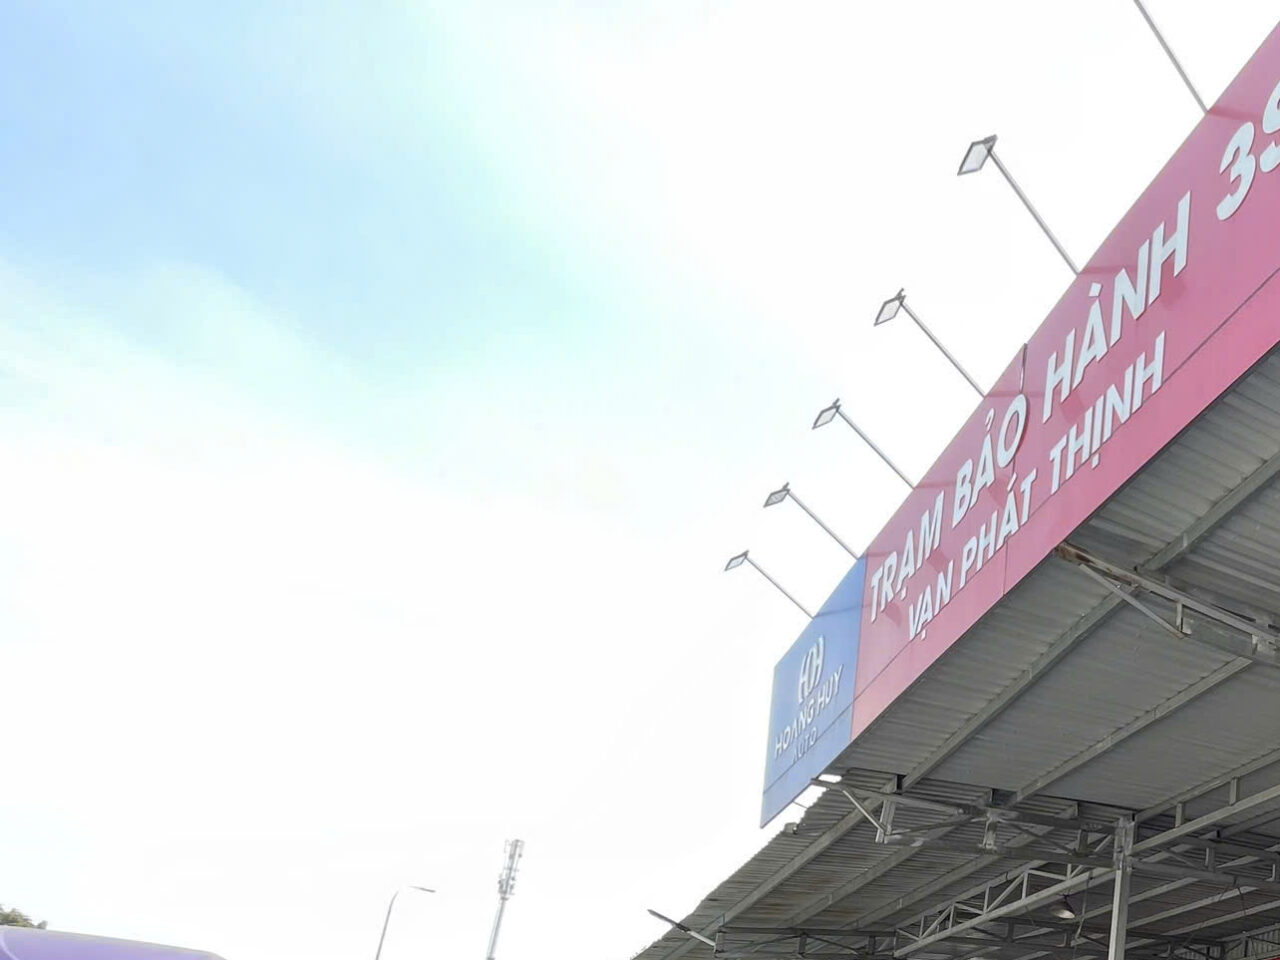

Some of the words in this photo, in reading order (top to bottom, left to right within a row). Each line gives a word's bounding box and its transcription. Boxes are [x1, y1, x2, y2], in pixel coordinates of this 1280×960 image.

[870, 490, 945, 624] TRẠM
[952, 394, 1027, 529] BẢO
[1042, 190, 1191, 424] HÀNH
[908, 559, 955, 642] VẠN
[959, 467, 1038, 589] PHÁT
[1049, 329, 1166, 495] THỊNH
[793, 726, 818, 763] AUTO
[816, 664, 844, 711] HUY
